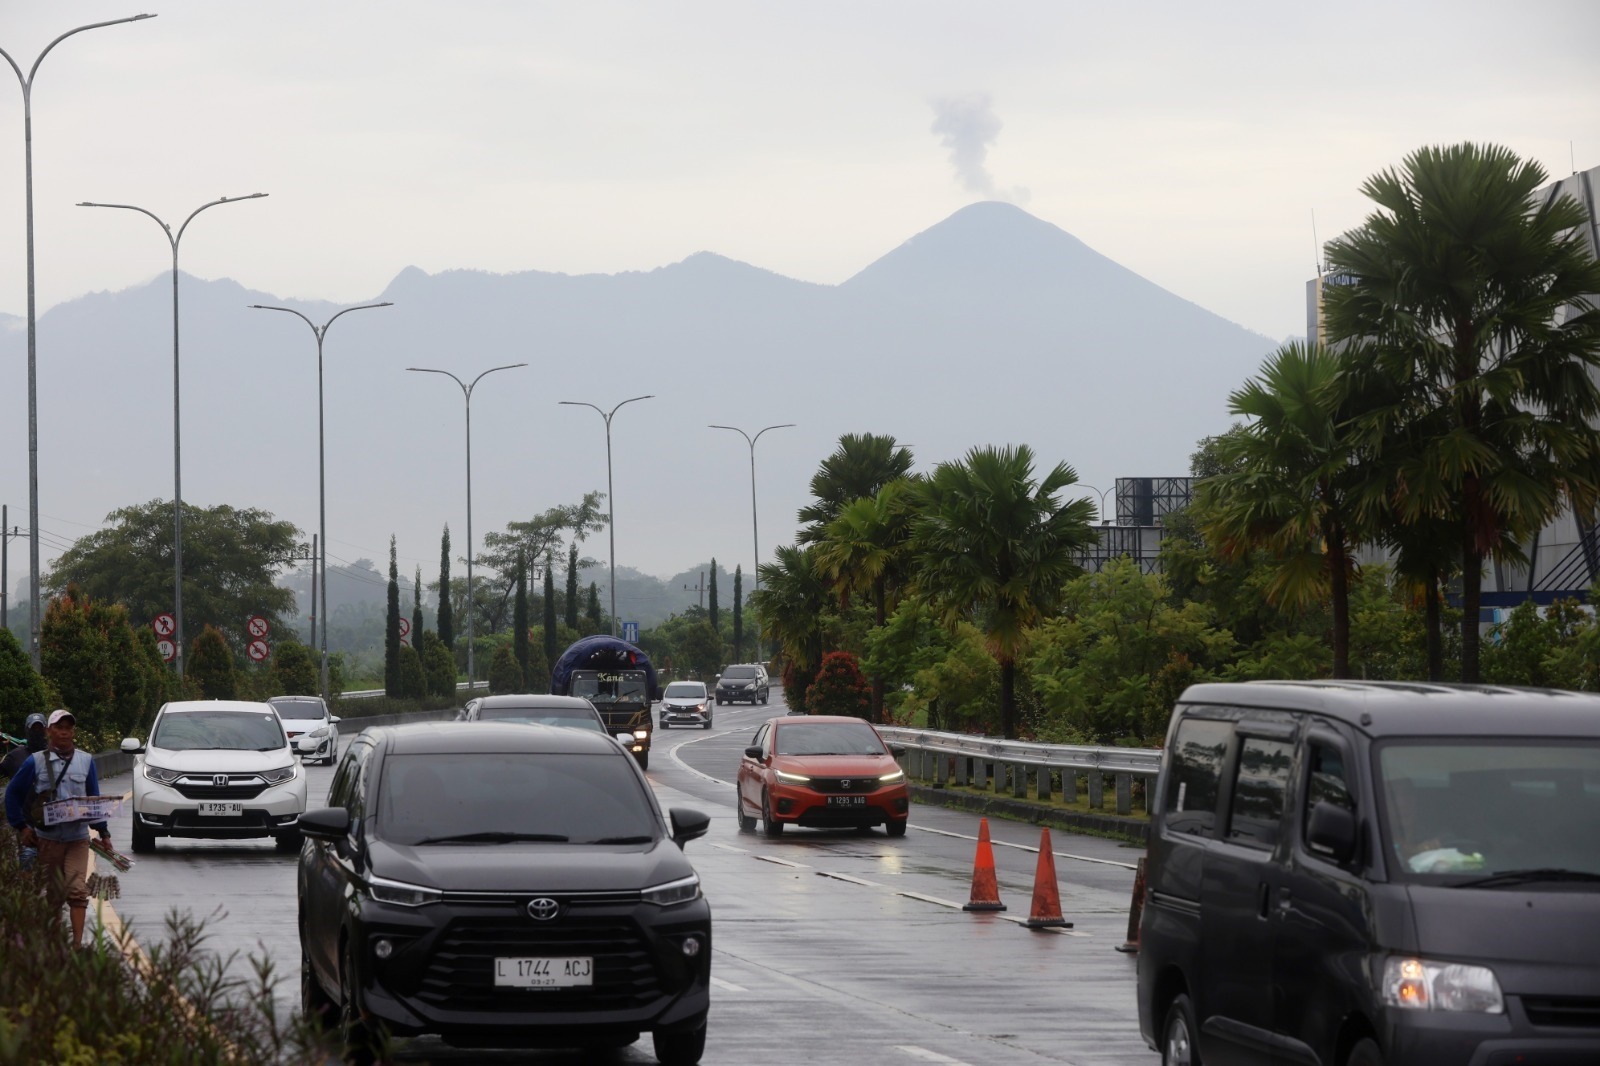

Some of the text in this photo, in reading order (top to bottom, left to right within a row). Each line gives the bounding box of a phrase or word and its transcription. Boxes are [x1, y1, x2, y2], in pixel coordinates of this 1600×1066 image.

[827, 796, 832, 804] N
[835, 796, 850, 804] 1295
[200, 803, 204, 812] N
[232, 803, 241, 812] AU
[498, 960, 591, 977] L 1744 ACJ
